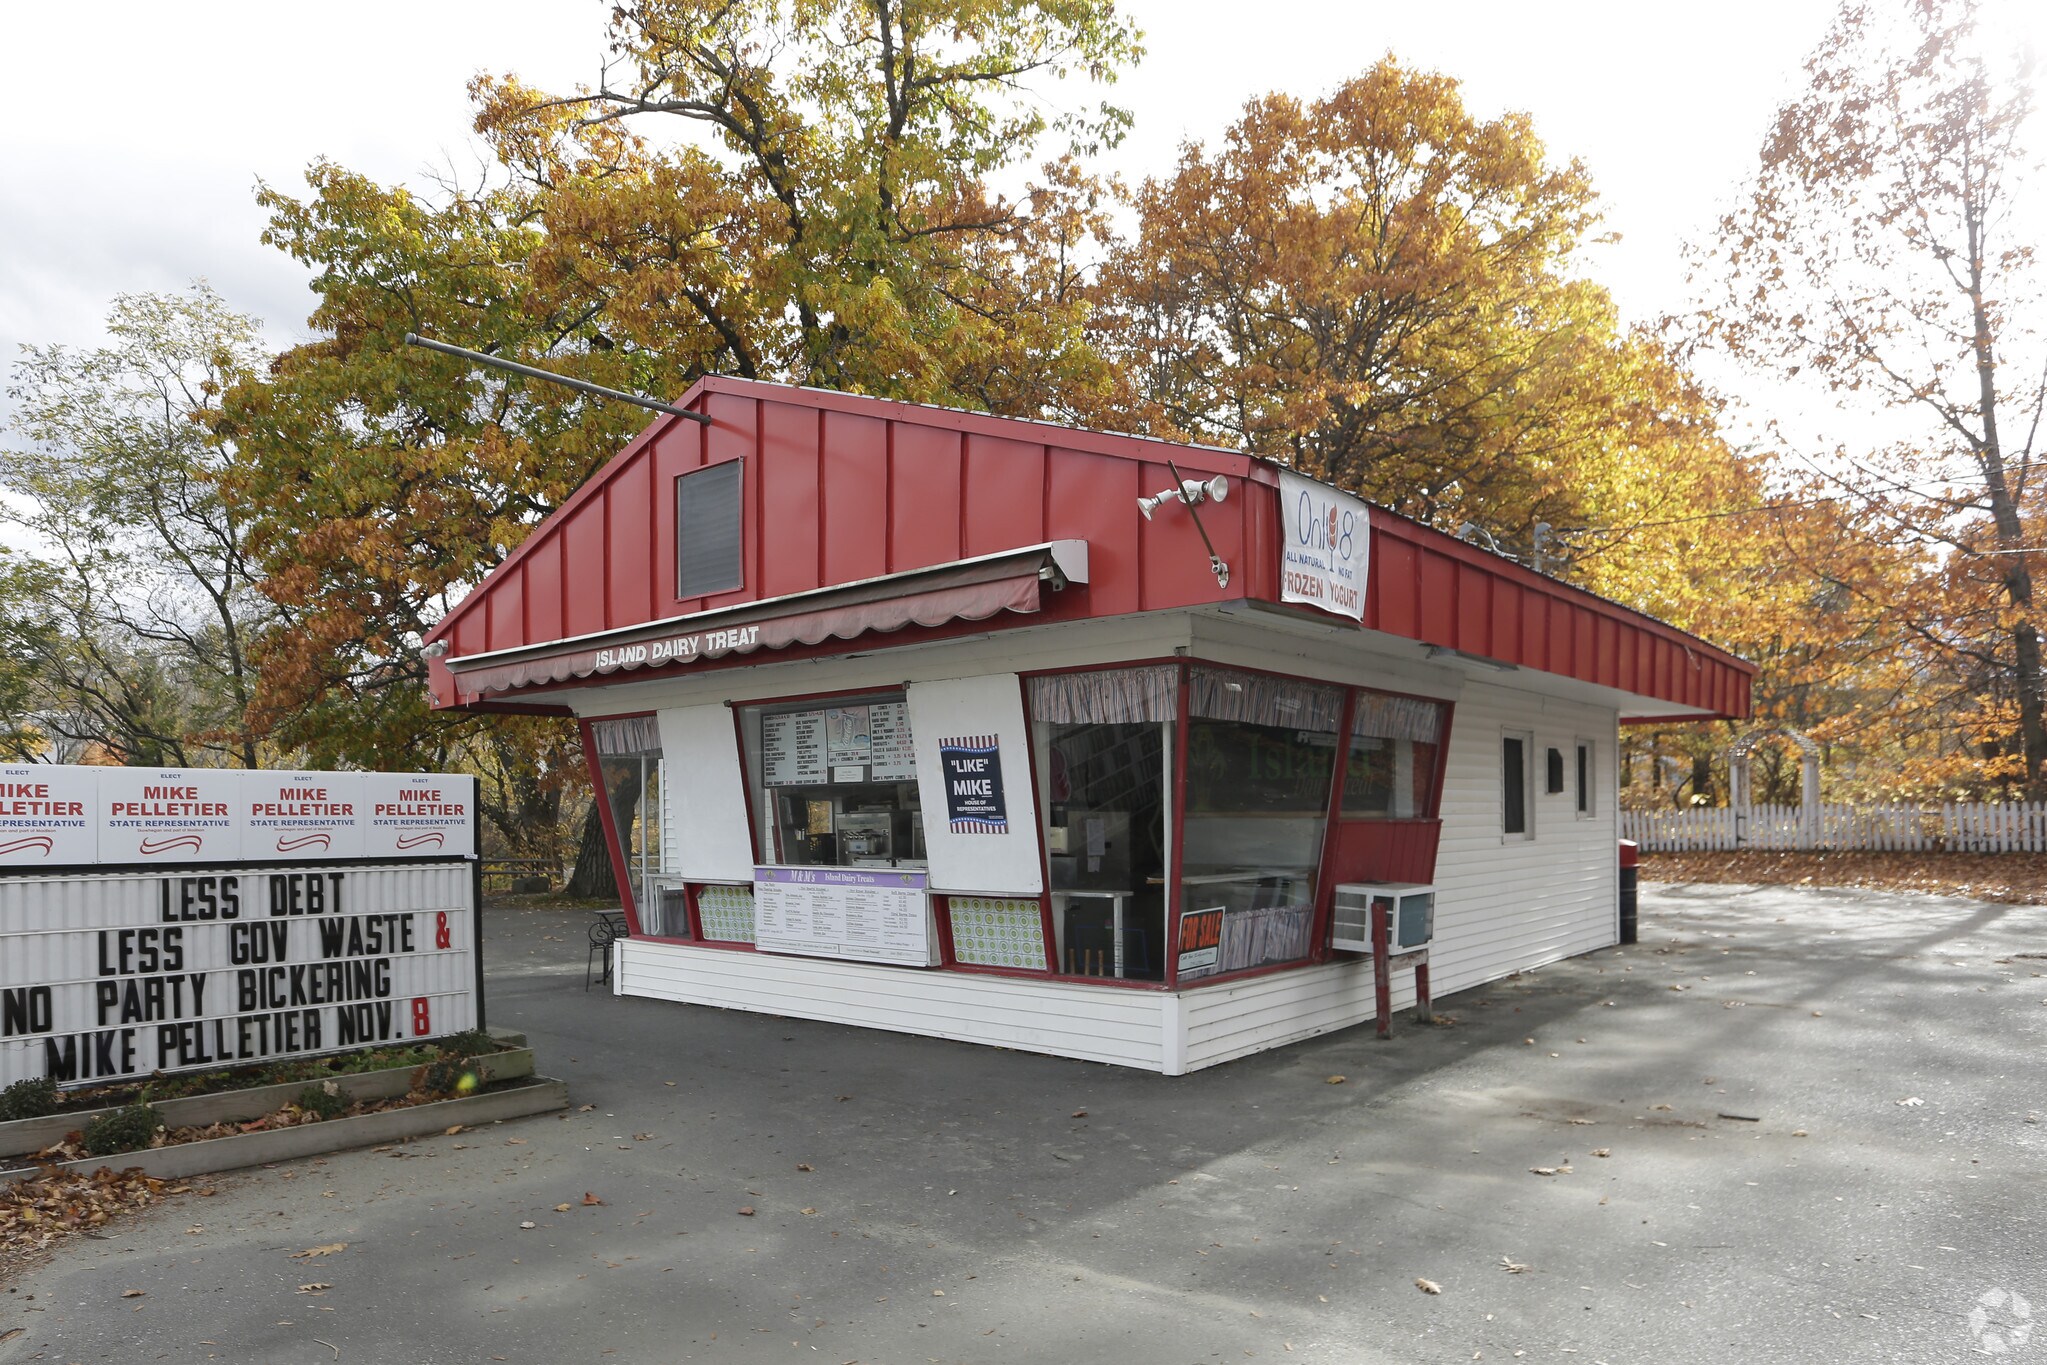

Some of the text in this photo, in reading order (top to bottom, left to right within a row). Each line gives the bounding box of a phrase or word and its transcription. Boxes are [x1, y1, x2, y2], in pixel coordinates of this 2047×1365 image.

[1340, 510, 1354, 561] 8
[1286, 551, 1326, 570] ALL NATURAL
[1338, 566, 1353, 580] NO FAT
[1329, 580, 1358, 610] YOGURT
[595, 625, 760, 668] ISLAND DAIRY TREAT
[950, 758, 989, 773] "LIKE"
[144, 786, 198, 800] MIKE
[280, 788, 327, 801] MIKE
[399, 789, 441, 801] MIKE
[953, 779, 993, 796] MIKE
[111, 802, 228, 816] PELLETIER
[252, 803, 354, 816] PELLETIER
[375, 804, 464, 816] PELLETIER
[825, 872, 841, 881] Island
[841, 873, 856, 883] Dairy
[857, 874, 875, 883] Treats
[161, 872, 345, 922] LESS DEBT
[1180, 912, 1223, 951] FOR SALE
[99, 911, 451, 977] LESS GOV WASTE &
[3, 958, 391, 1036] NO PARTY BICKERING
[45, 996, 430, 1082] MIKE PELLETIER NOV. 8
